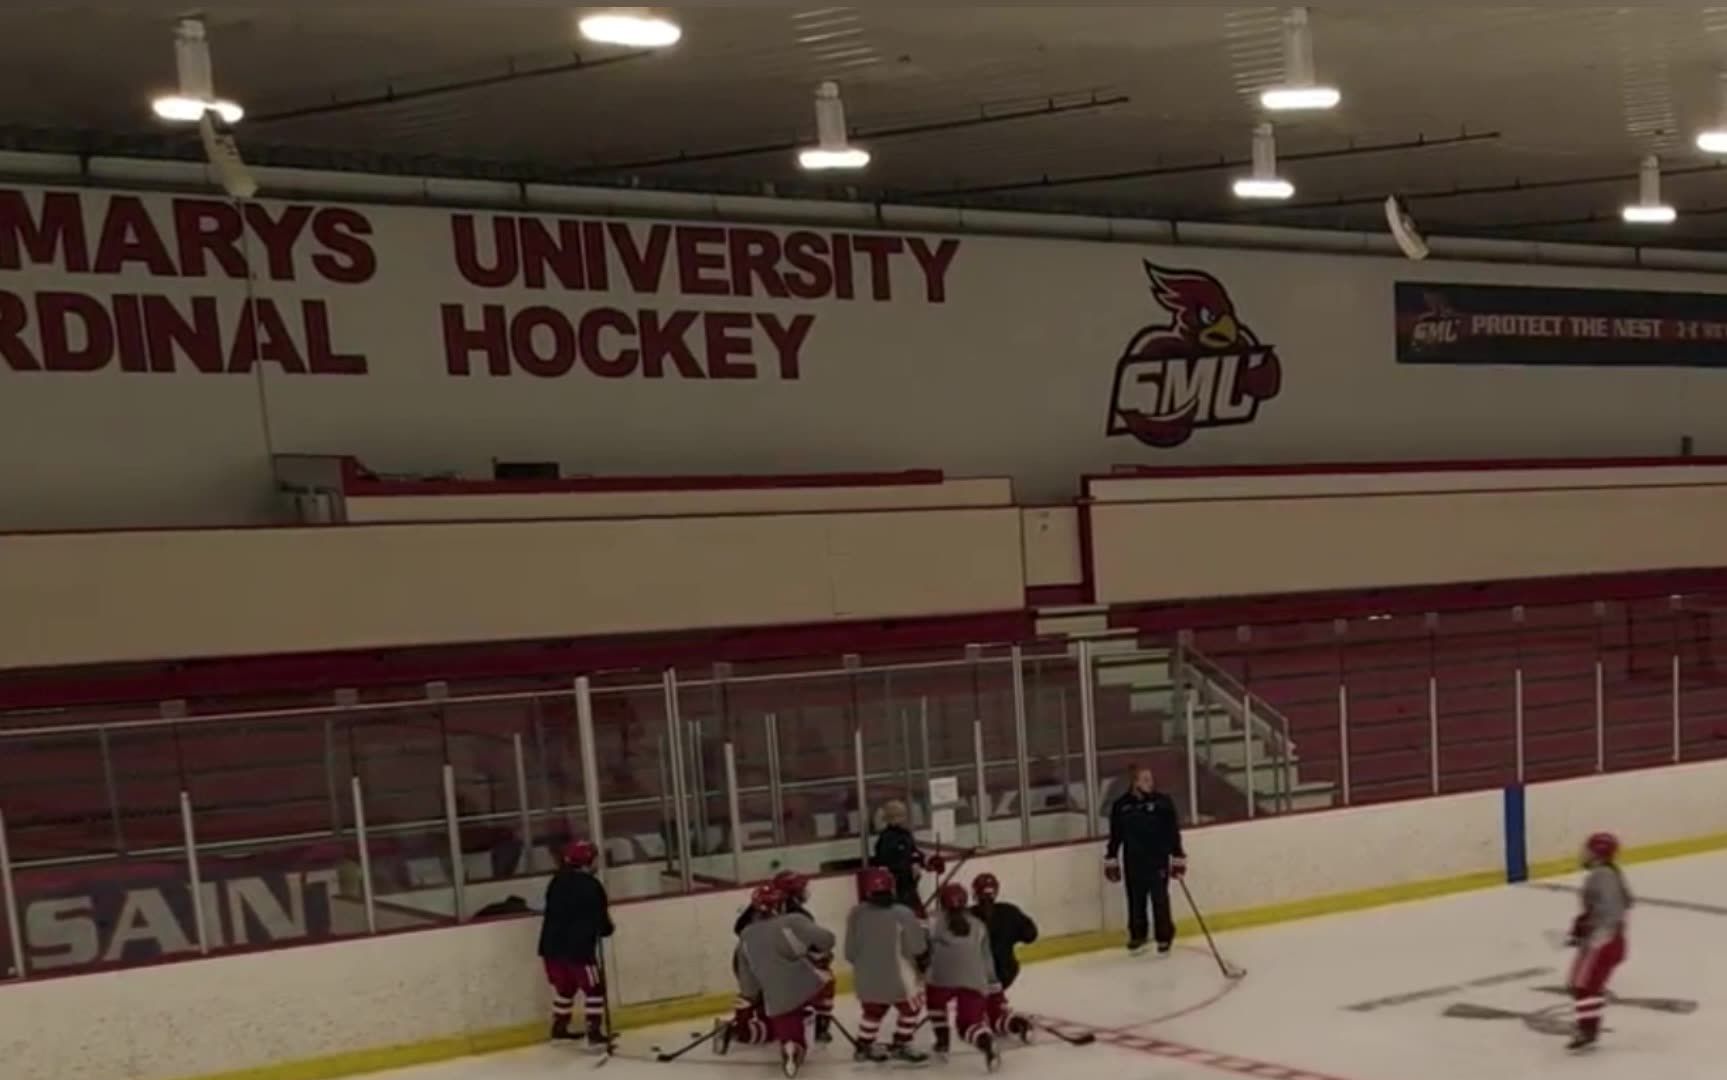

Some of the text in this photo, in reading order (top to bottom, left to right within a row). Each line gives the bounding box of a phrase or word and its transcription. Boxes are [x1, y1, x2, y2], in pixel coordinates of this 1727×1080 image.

[0, 190, 960, 304] MARYS UNIVERSITY
[441, 302, 816, 380] HOCKEY
[1472, 314, 1664, 339] PROTECT THE NEST
